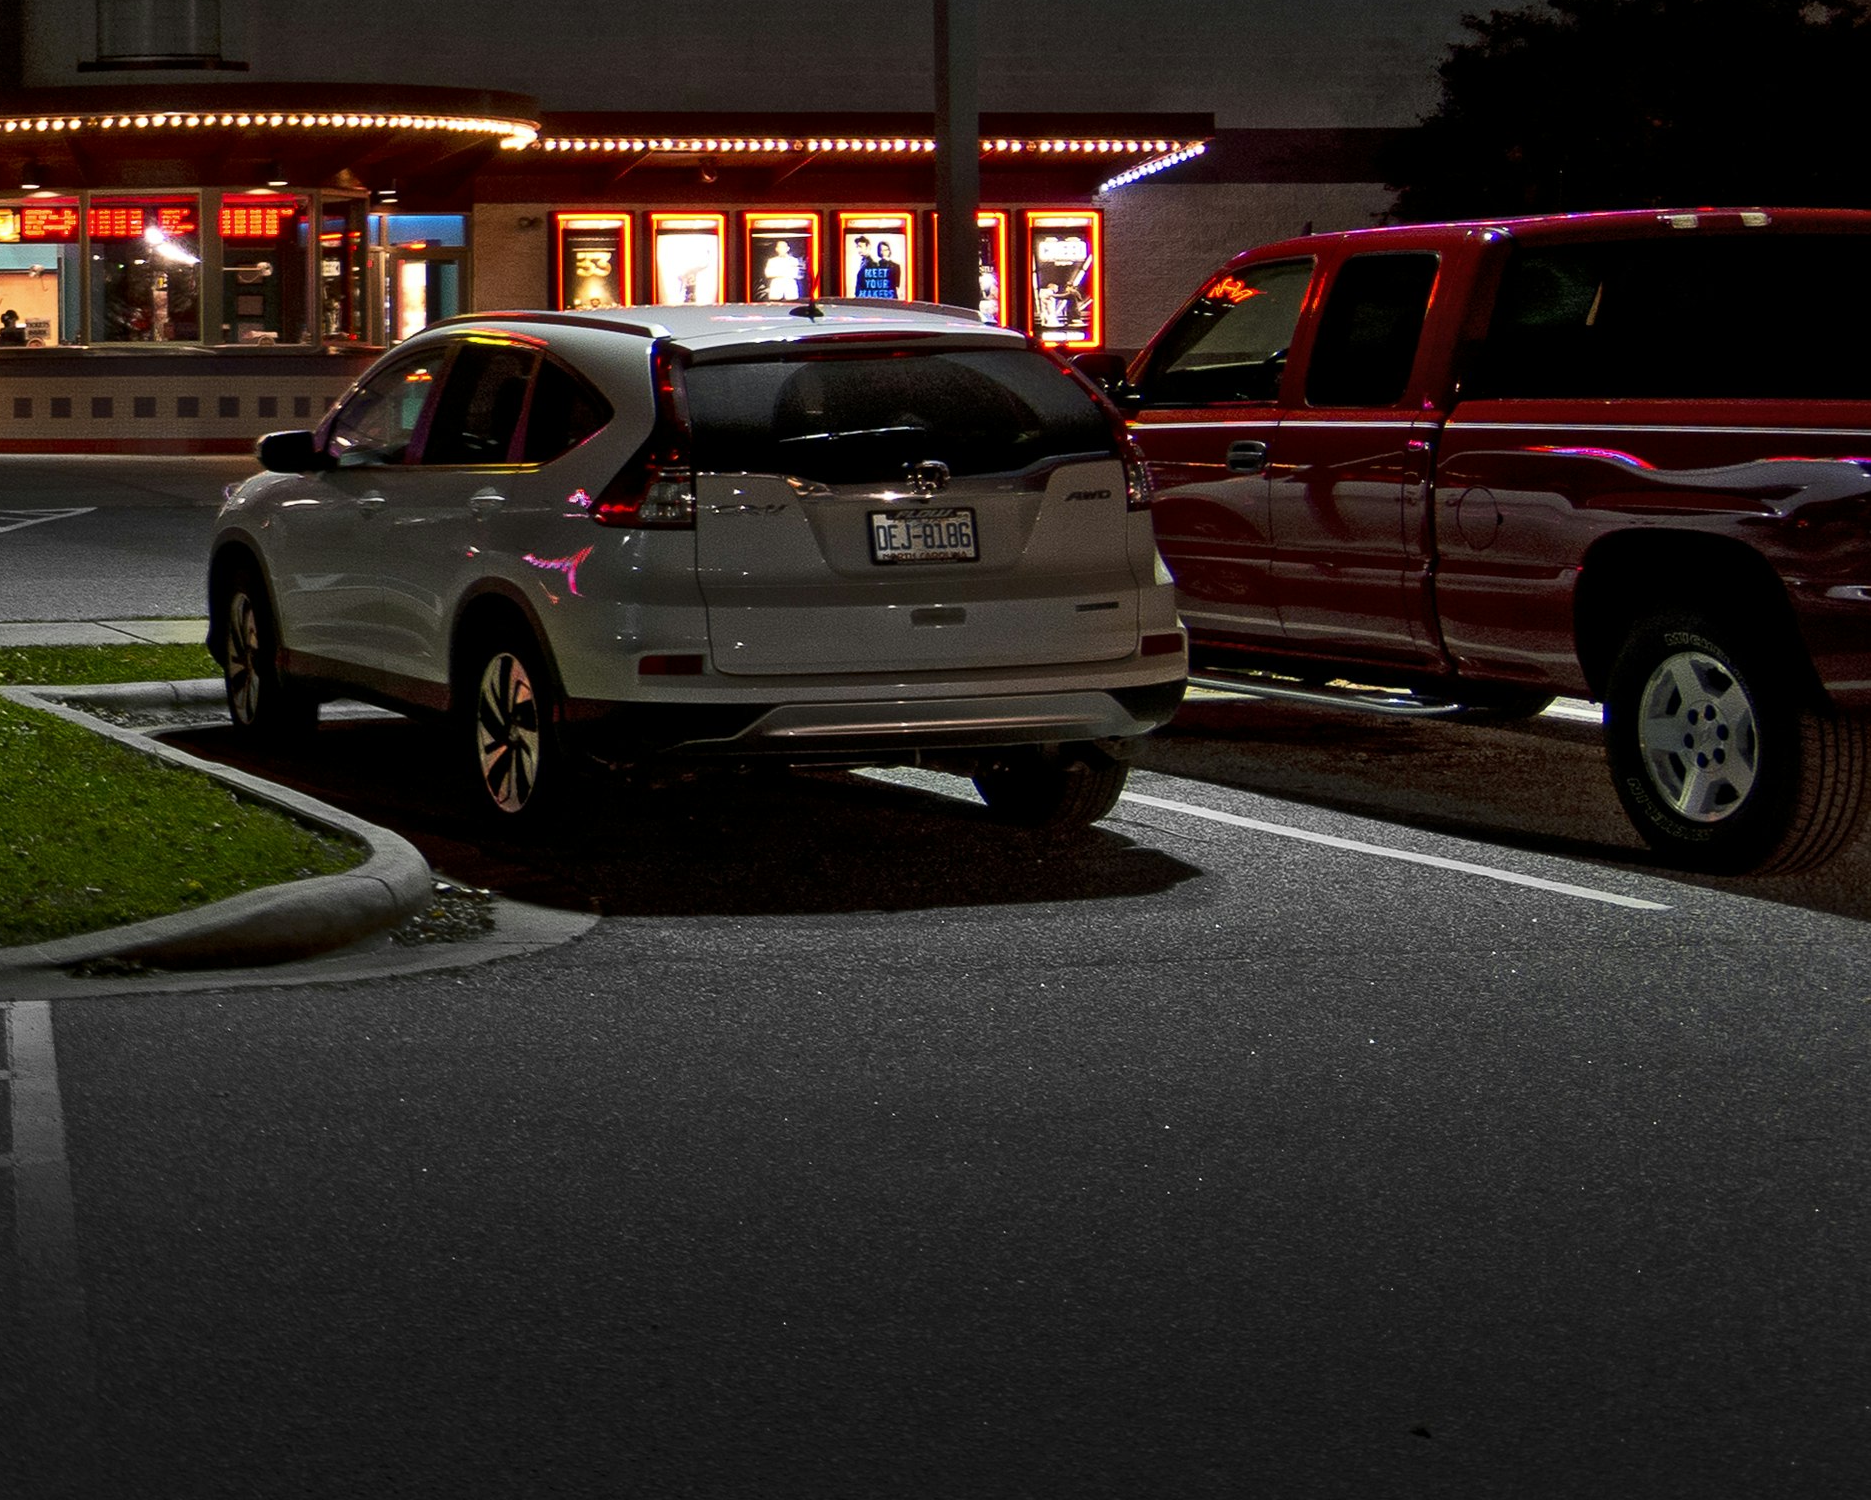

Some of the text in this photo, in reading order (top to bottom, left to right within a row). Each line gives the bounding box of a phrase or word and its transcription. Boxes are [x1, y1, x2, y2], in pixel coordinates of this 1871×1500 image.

[864, 268, 888, 278] MEET
[865, 279, 890, 289] YOUR
[858, 290, 895, 299] MAKERS
[1065, 490, 1112, 501] AWD
[895, 509, 956, 519] FLOW
[876, 521, 972, 551] DEJ-8186
